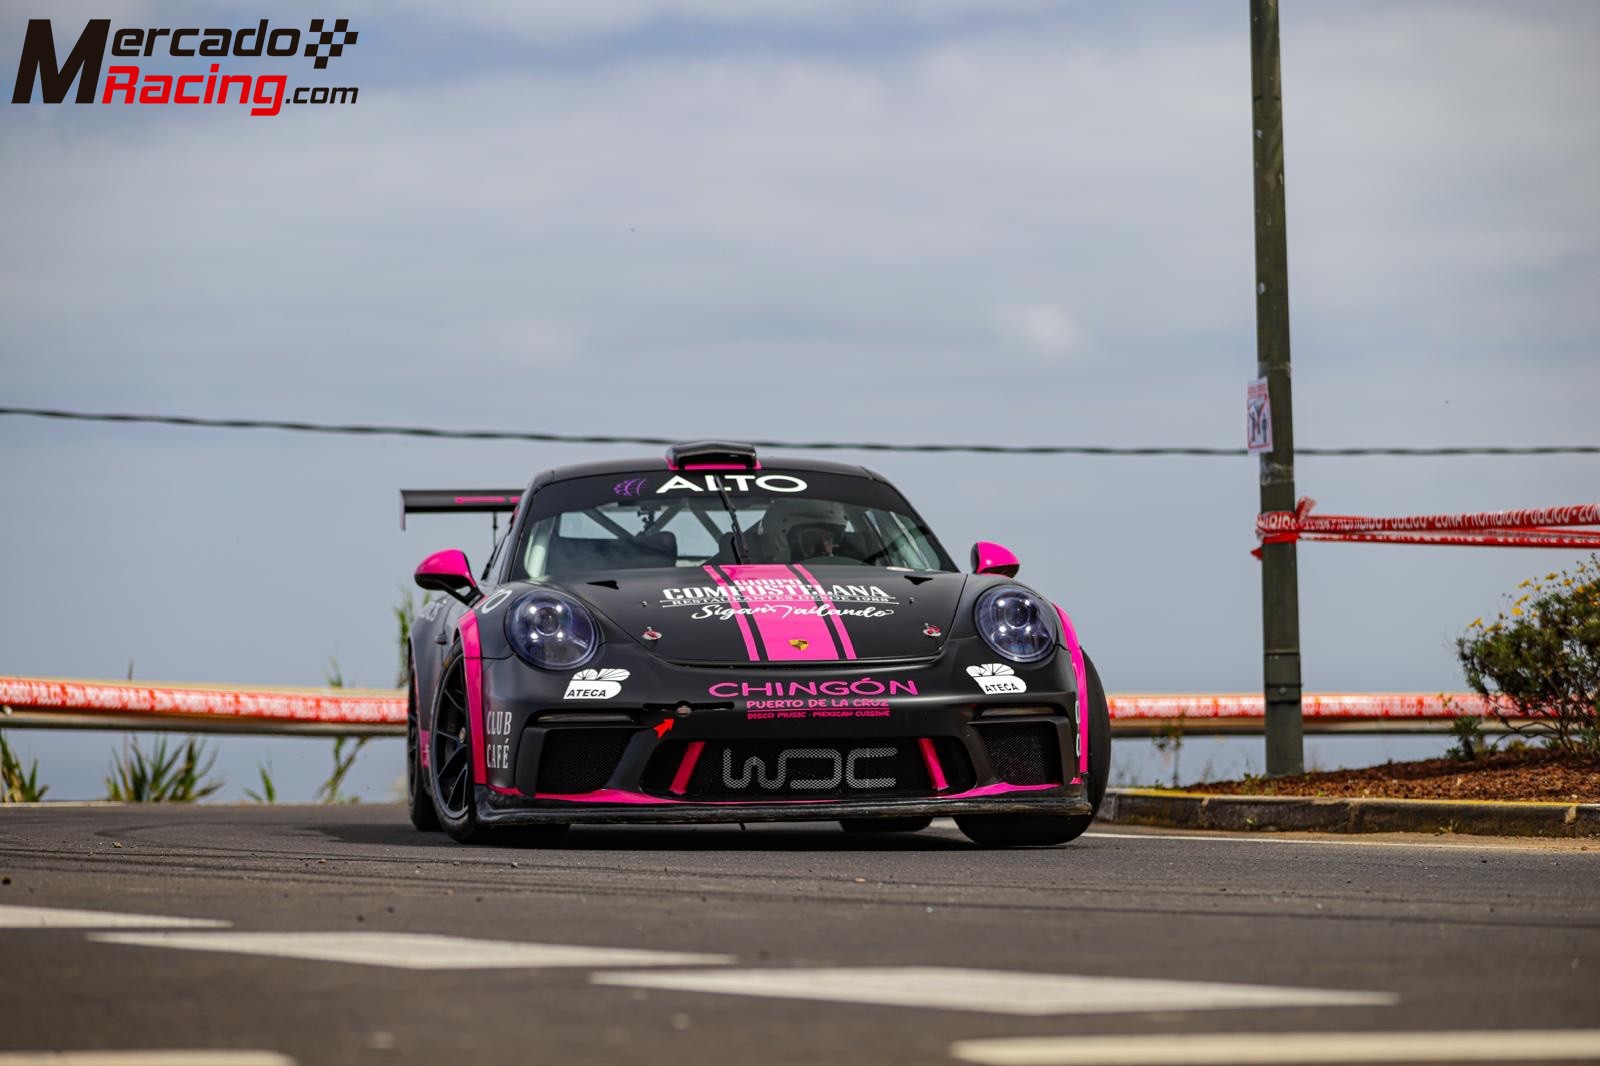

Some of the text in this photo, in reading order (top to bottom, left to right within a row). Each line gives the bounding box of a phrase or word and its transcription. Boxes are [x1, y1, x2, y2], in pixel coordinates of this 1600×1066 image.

[656, 475, 808, 493] ALTO
[662, 585, 891, 600] COMPOSTELANA
[567, 689, 607, 697] ATECA
[708, 677, 919, 698] CHINGÓN
[984, 682, 1019, 693] ATECA
[746, 698, 890, 709] PUERTO DE LA CRUZ
[486, 711, 512, 736] CLUB
[486, 737, 510, 769] CAFÉ
